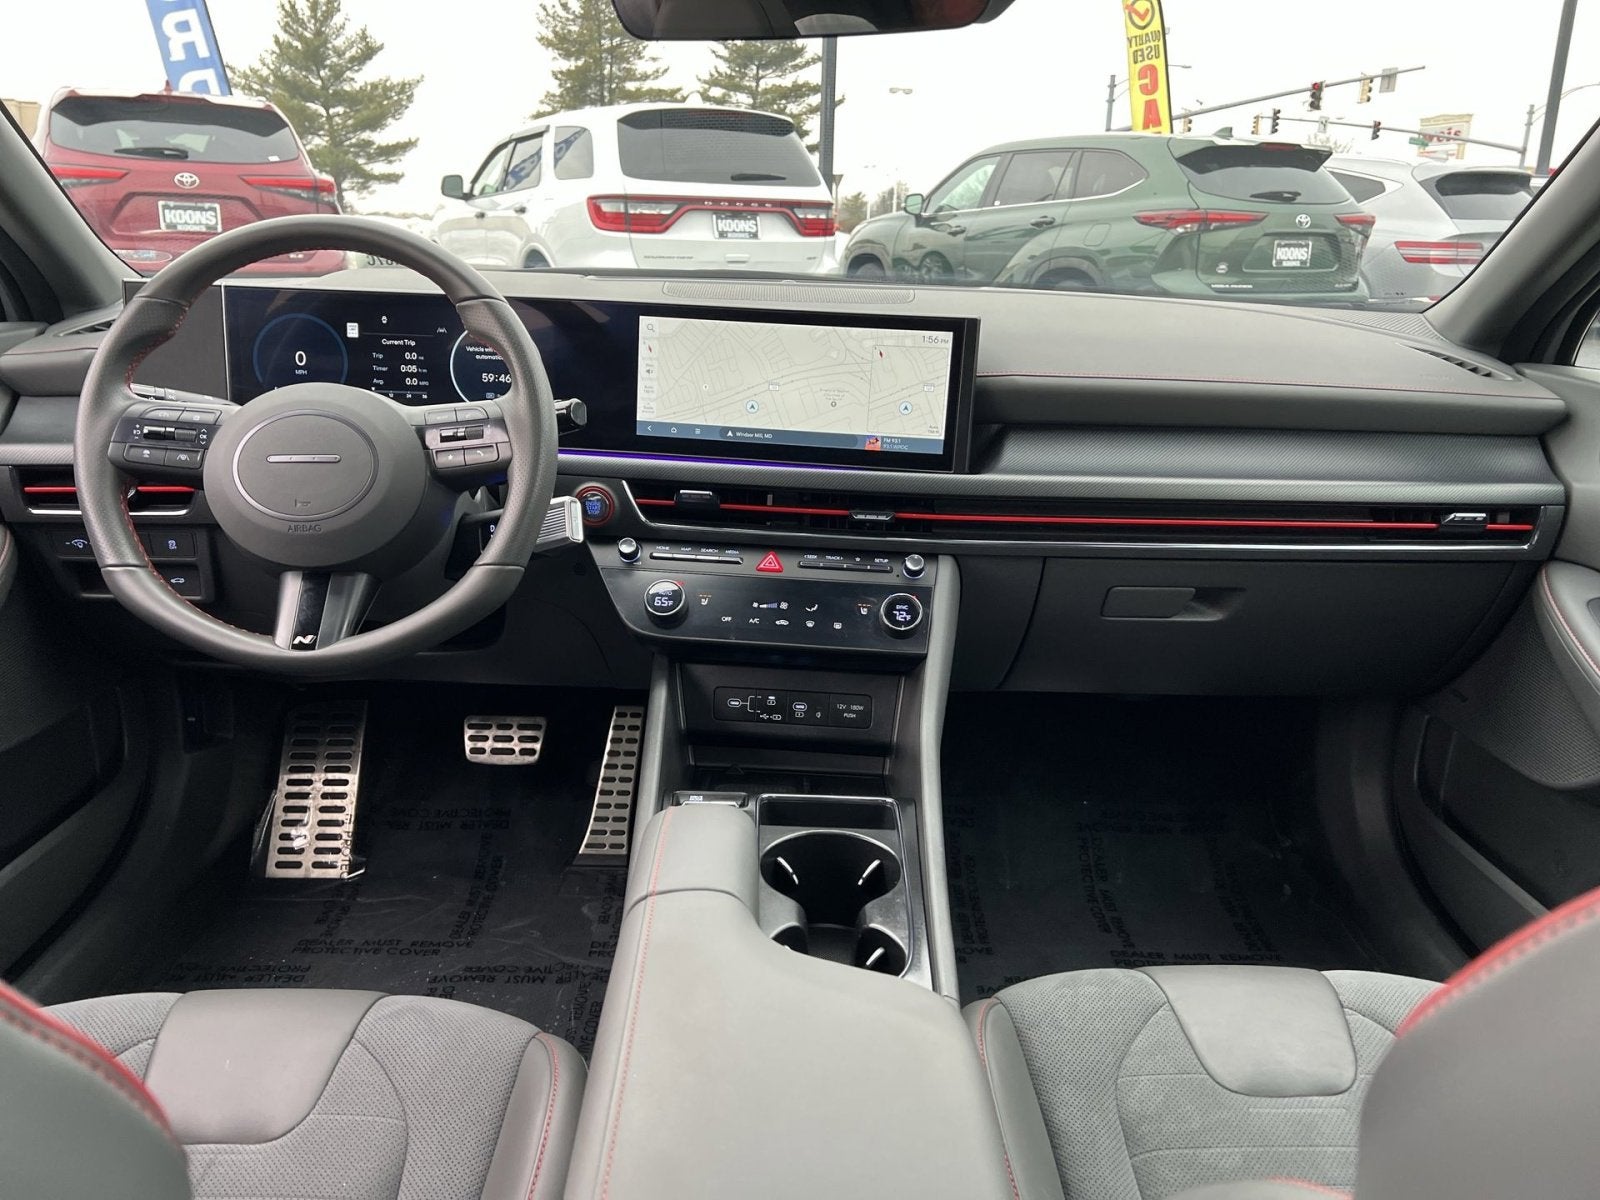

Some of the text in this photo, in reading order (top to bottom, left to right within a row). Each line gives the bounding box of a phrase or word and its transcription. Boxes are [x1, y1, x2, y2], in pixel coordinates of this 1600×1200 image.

[164, 209, 217, 225] KOONS
[717, 219, 758, 232] KOONS
[1276, 247, 1308, 260] KOONS
[381, 338, 416, 347] Current Trip
[922, 335, 940, 344] 1:56
[295, 350, 307, 366] 0
[404, 352, 418, 360] 0.0
[400, 364, 418, 373] 0:05
[405, 377, 418, 386] 0.0
[481, 373, 512, 383] 59:46
[287, 524, 323, 533] AIRBAG
[362, 938, 402, 947] MUST
[409, 939, 476, 949] REMOVE
[386, 948, 442, 957] COVER
[429, 974, 496, 984] REMOVE
[504, 974, 547, 985] MUST
